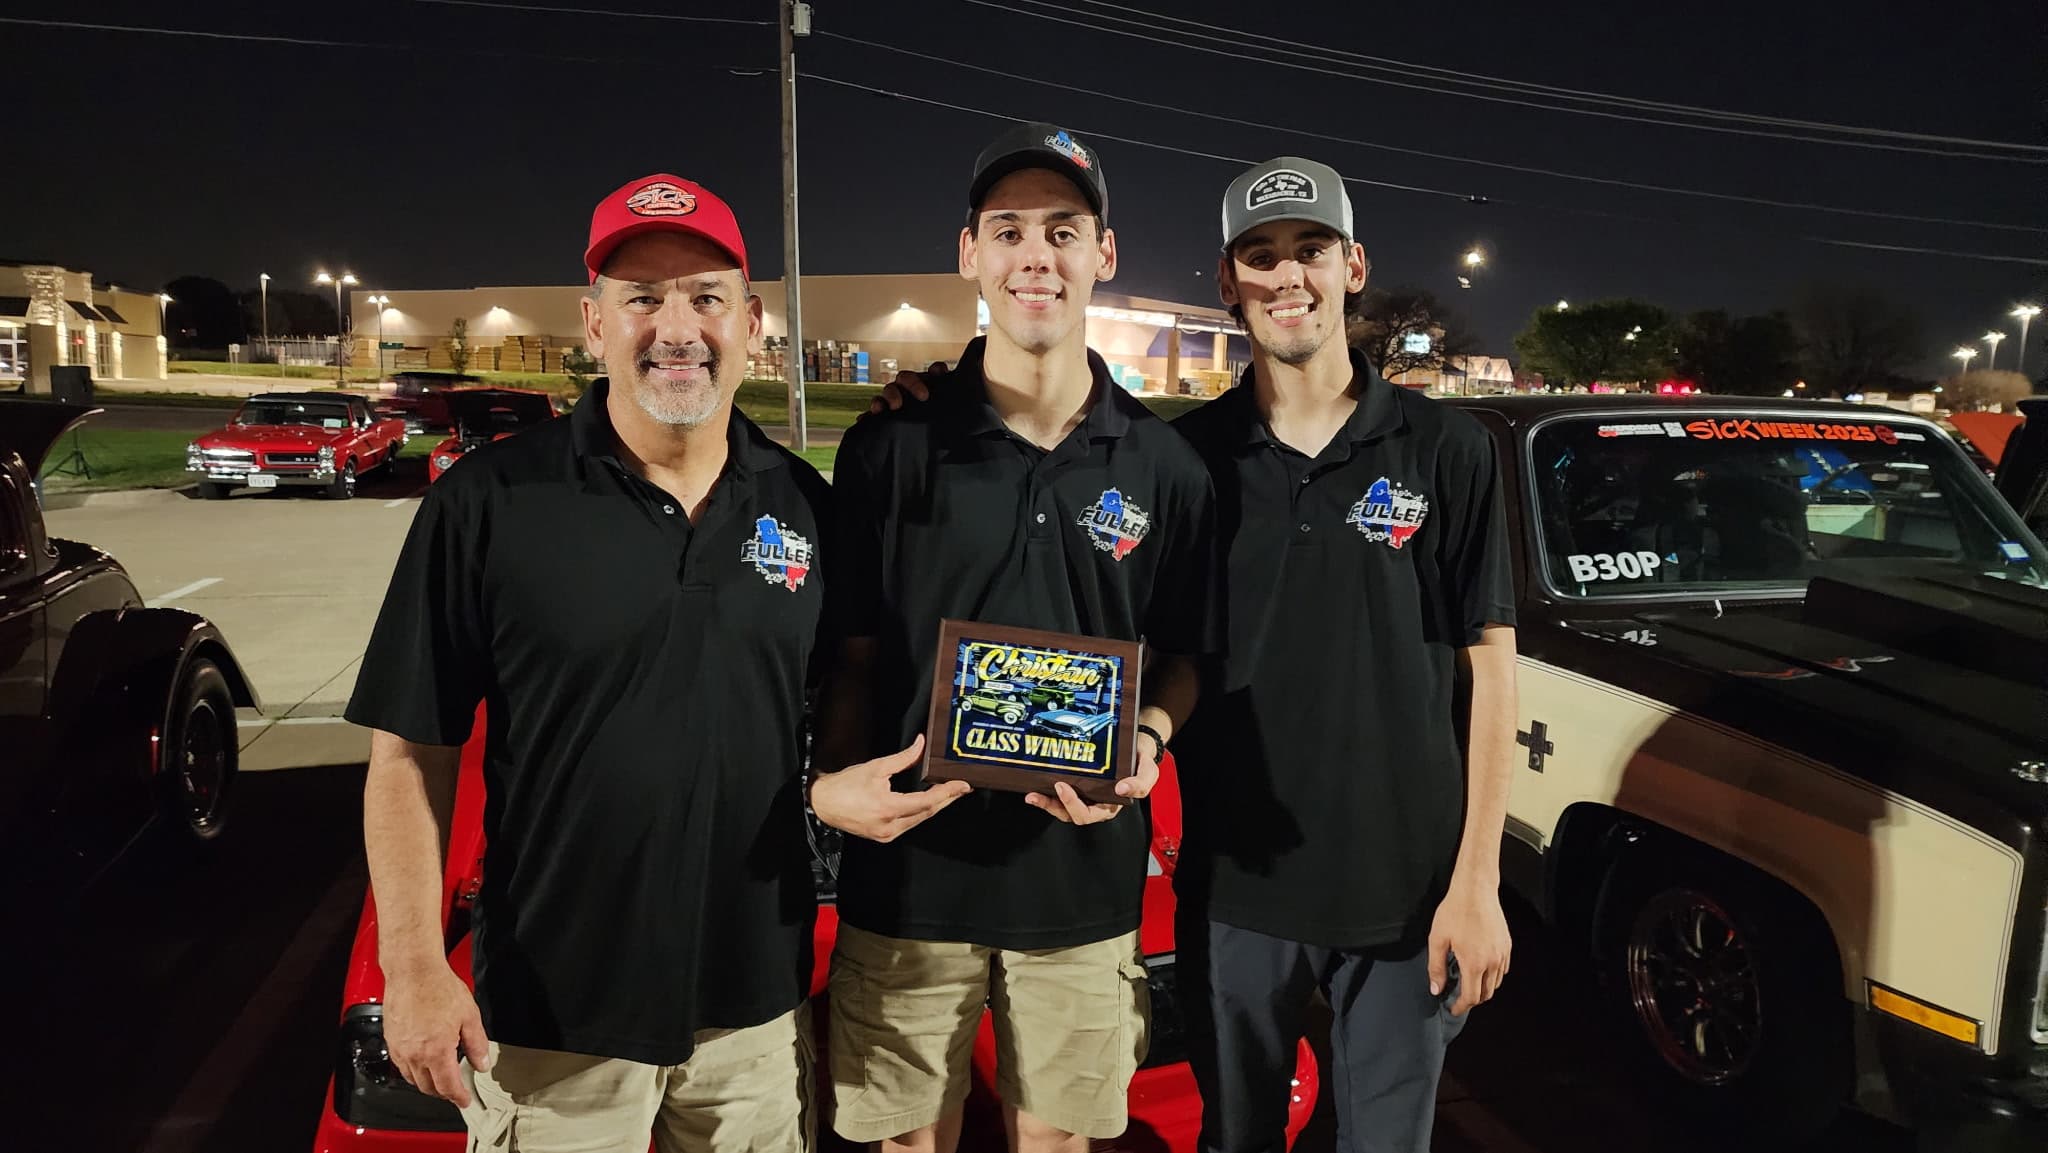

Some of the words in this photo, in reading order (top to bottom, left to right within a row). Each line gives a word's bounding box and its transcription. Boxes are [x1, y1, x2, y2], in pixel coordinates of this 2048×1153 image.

[626, 188, 696, 208] SICK
[1568, 551, 1660, 582] B30P
[978, 648, 1101, 686] Christian
[965, 728, 1020, 753] CLASS
[1024, 734, 1097, 762] WINNER
